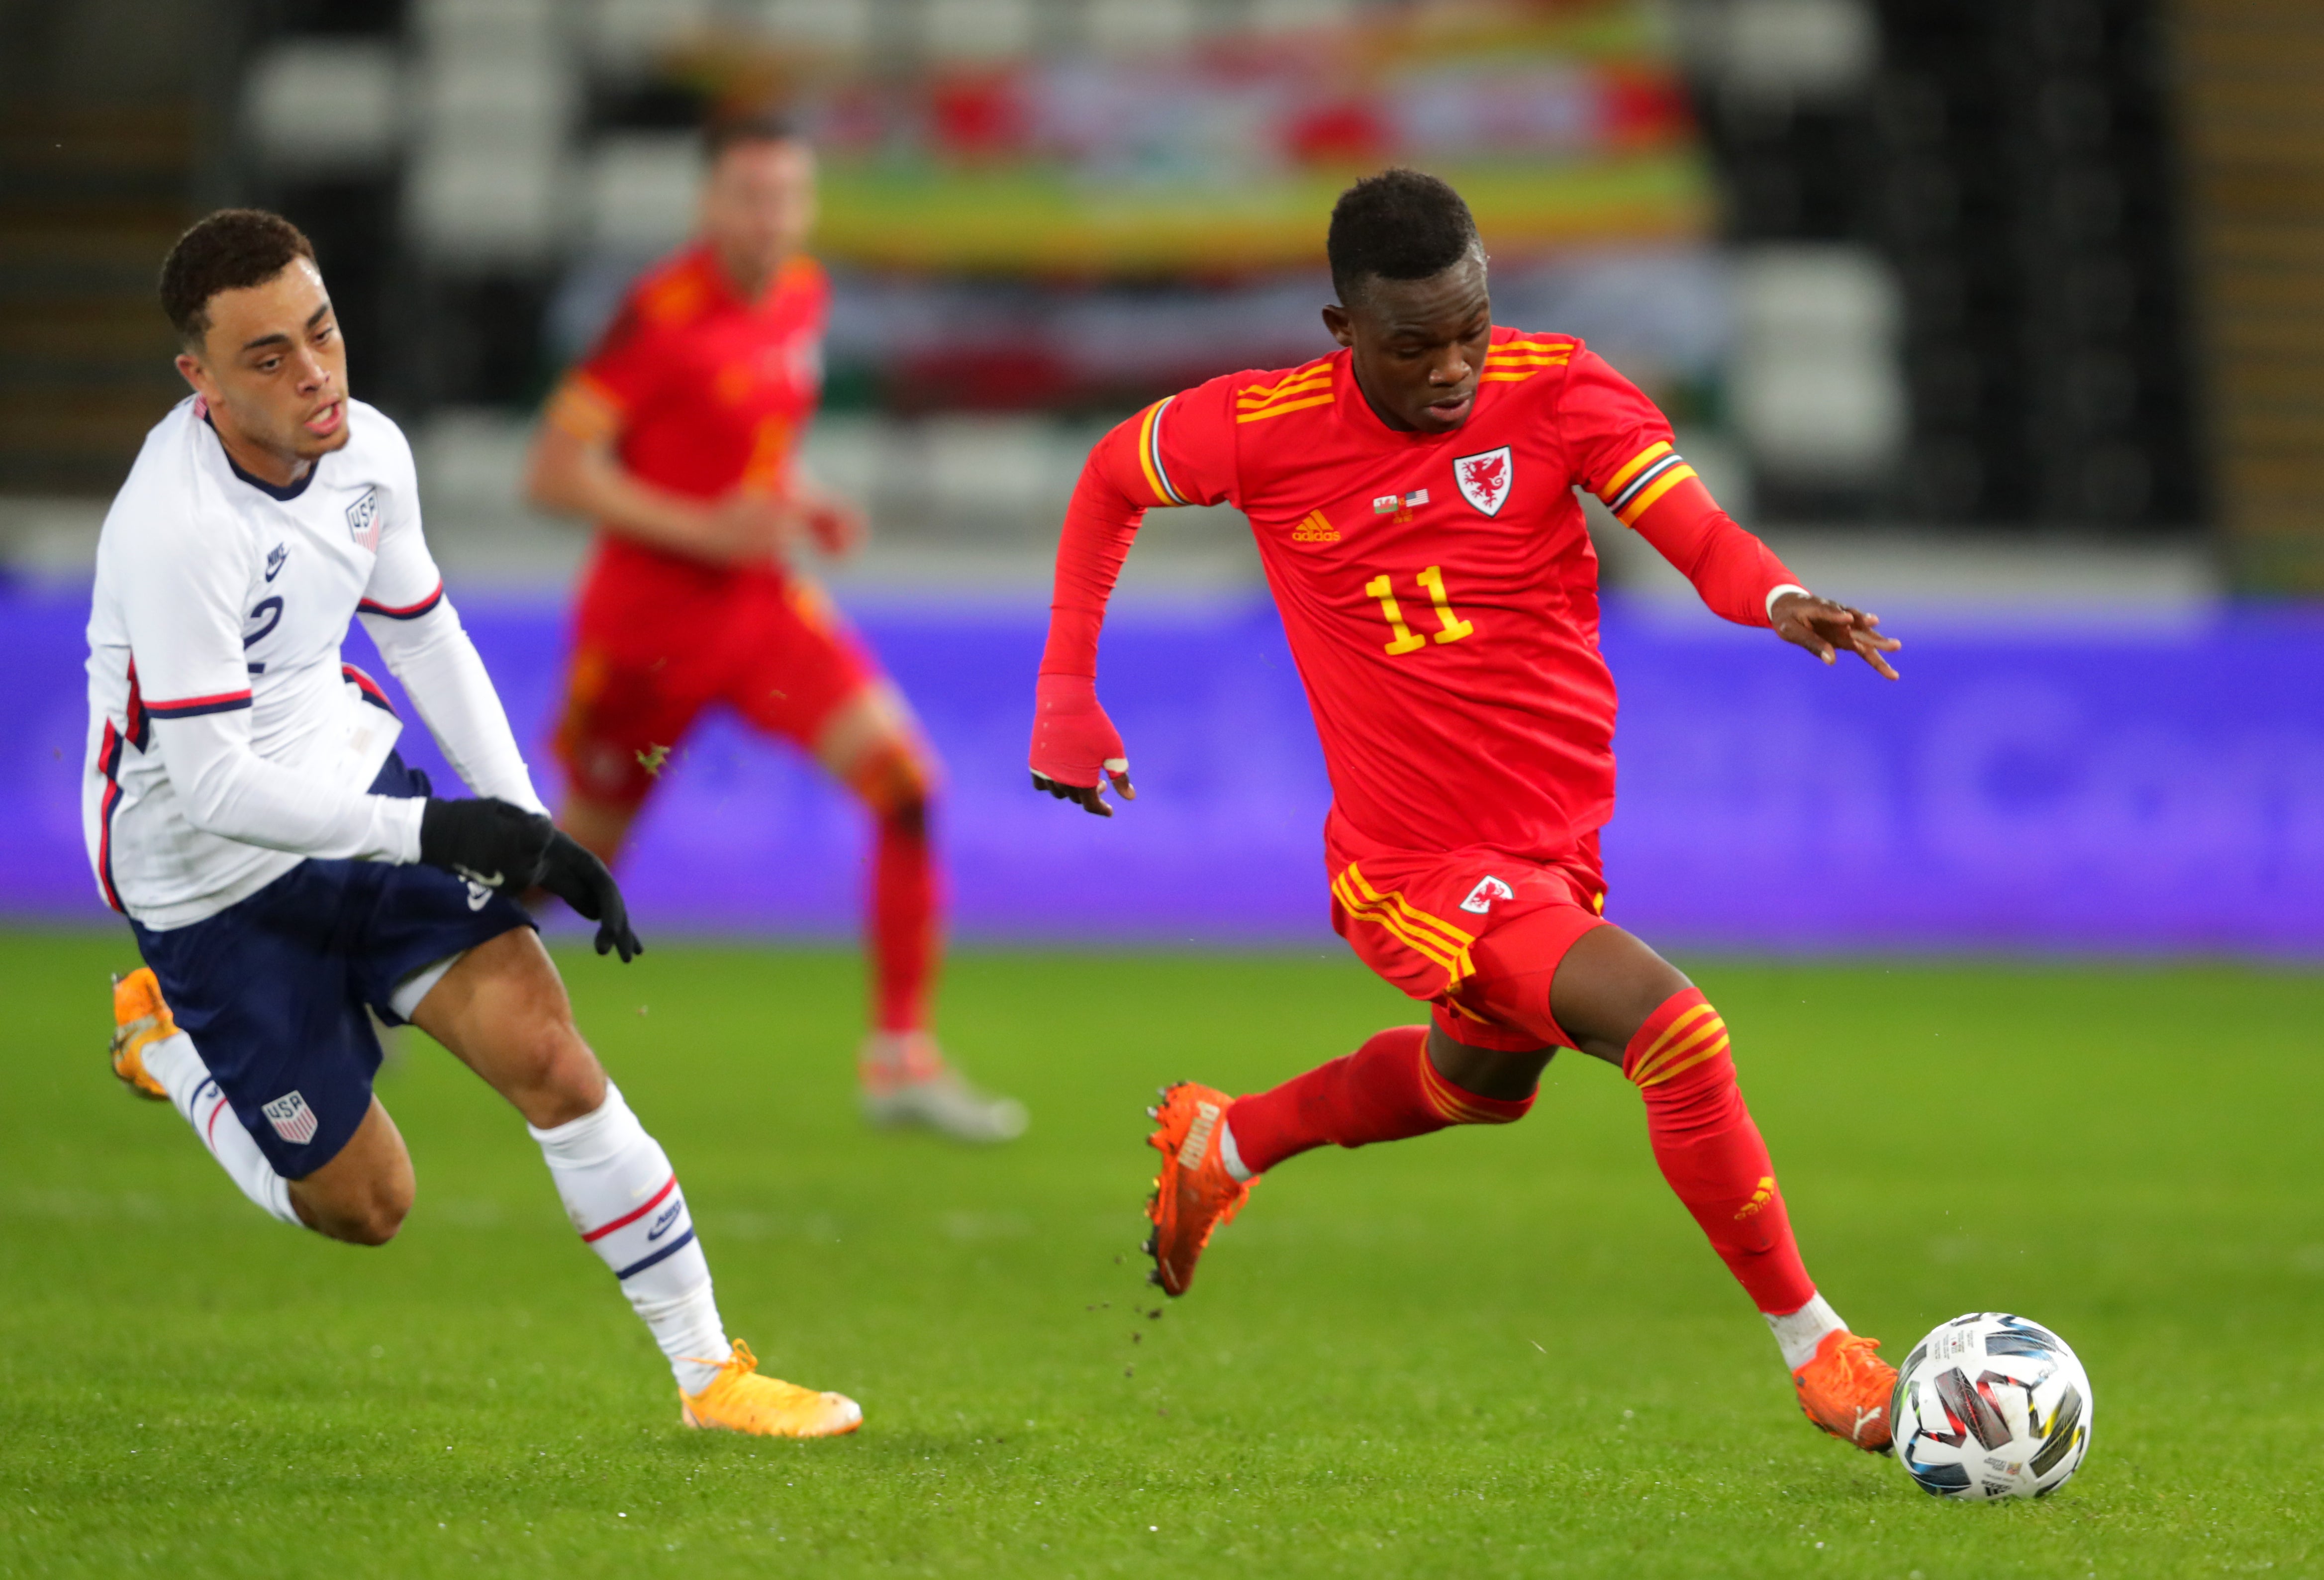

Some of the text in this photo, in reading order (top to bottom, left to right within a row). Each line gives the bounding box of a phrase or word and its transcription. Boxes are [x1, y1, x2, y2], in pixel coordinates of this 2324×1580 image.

[1292, 529, 1341, 542] adidas
[243, 595, 284, 674] 2
[1365, 565, 1474, 656] 11
